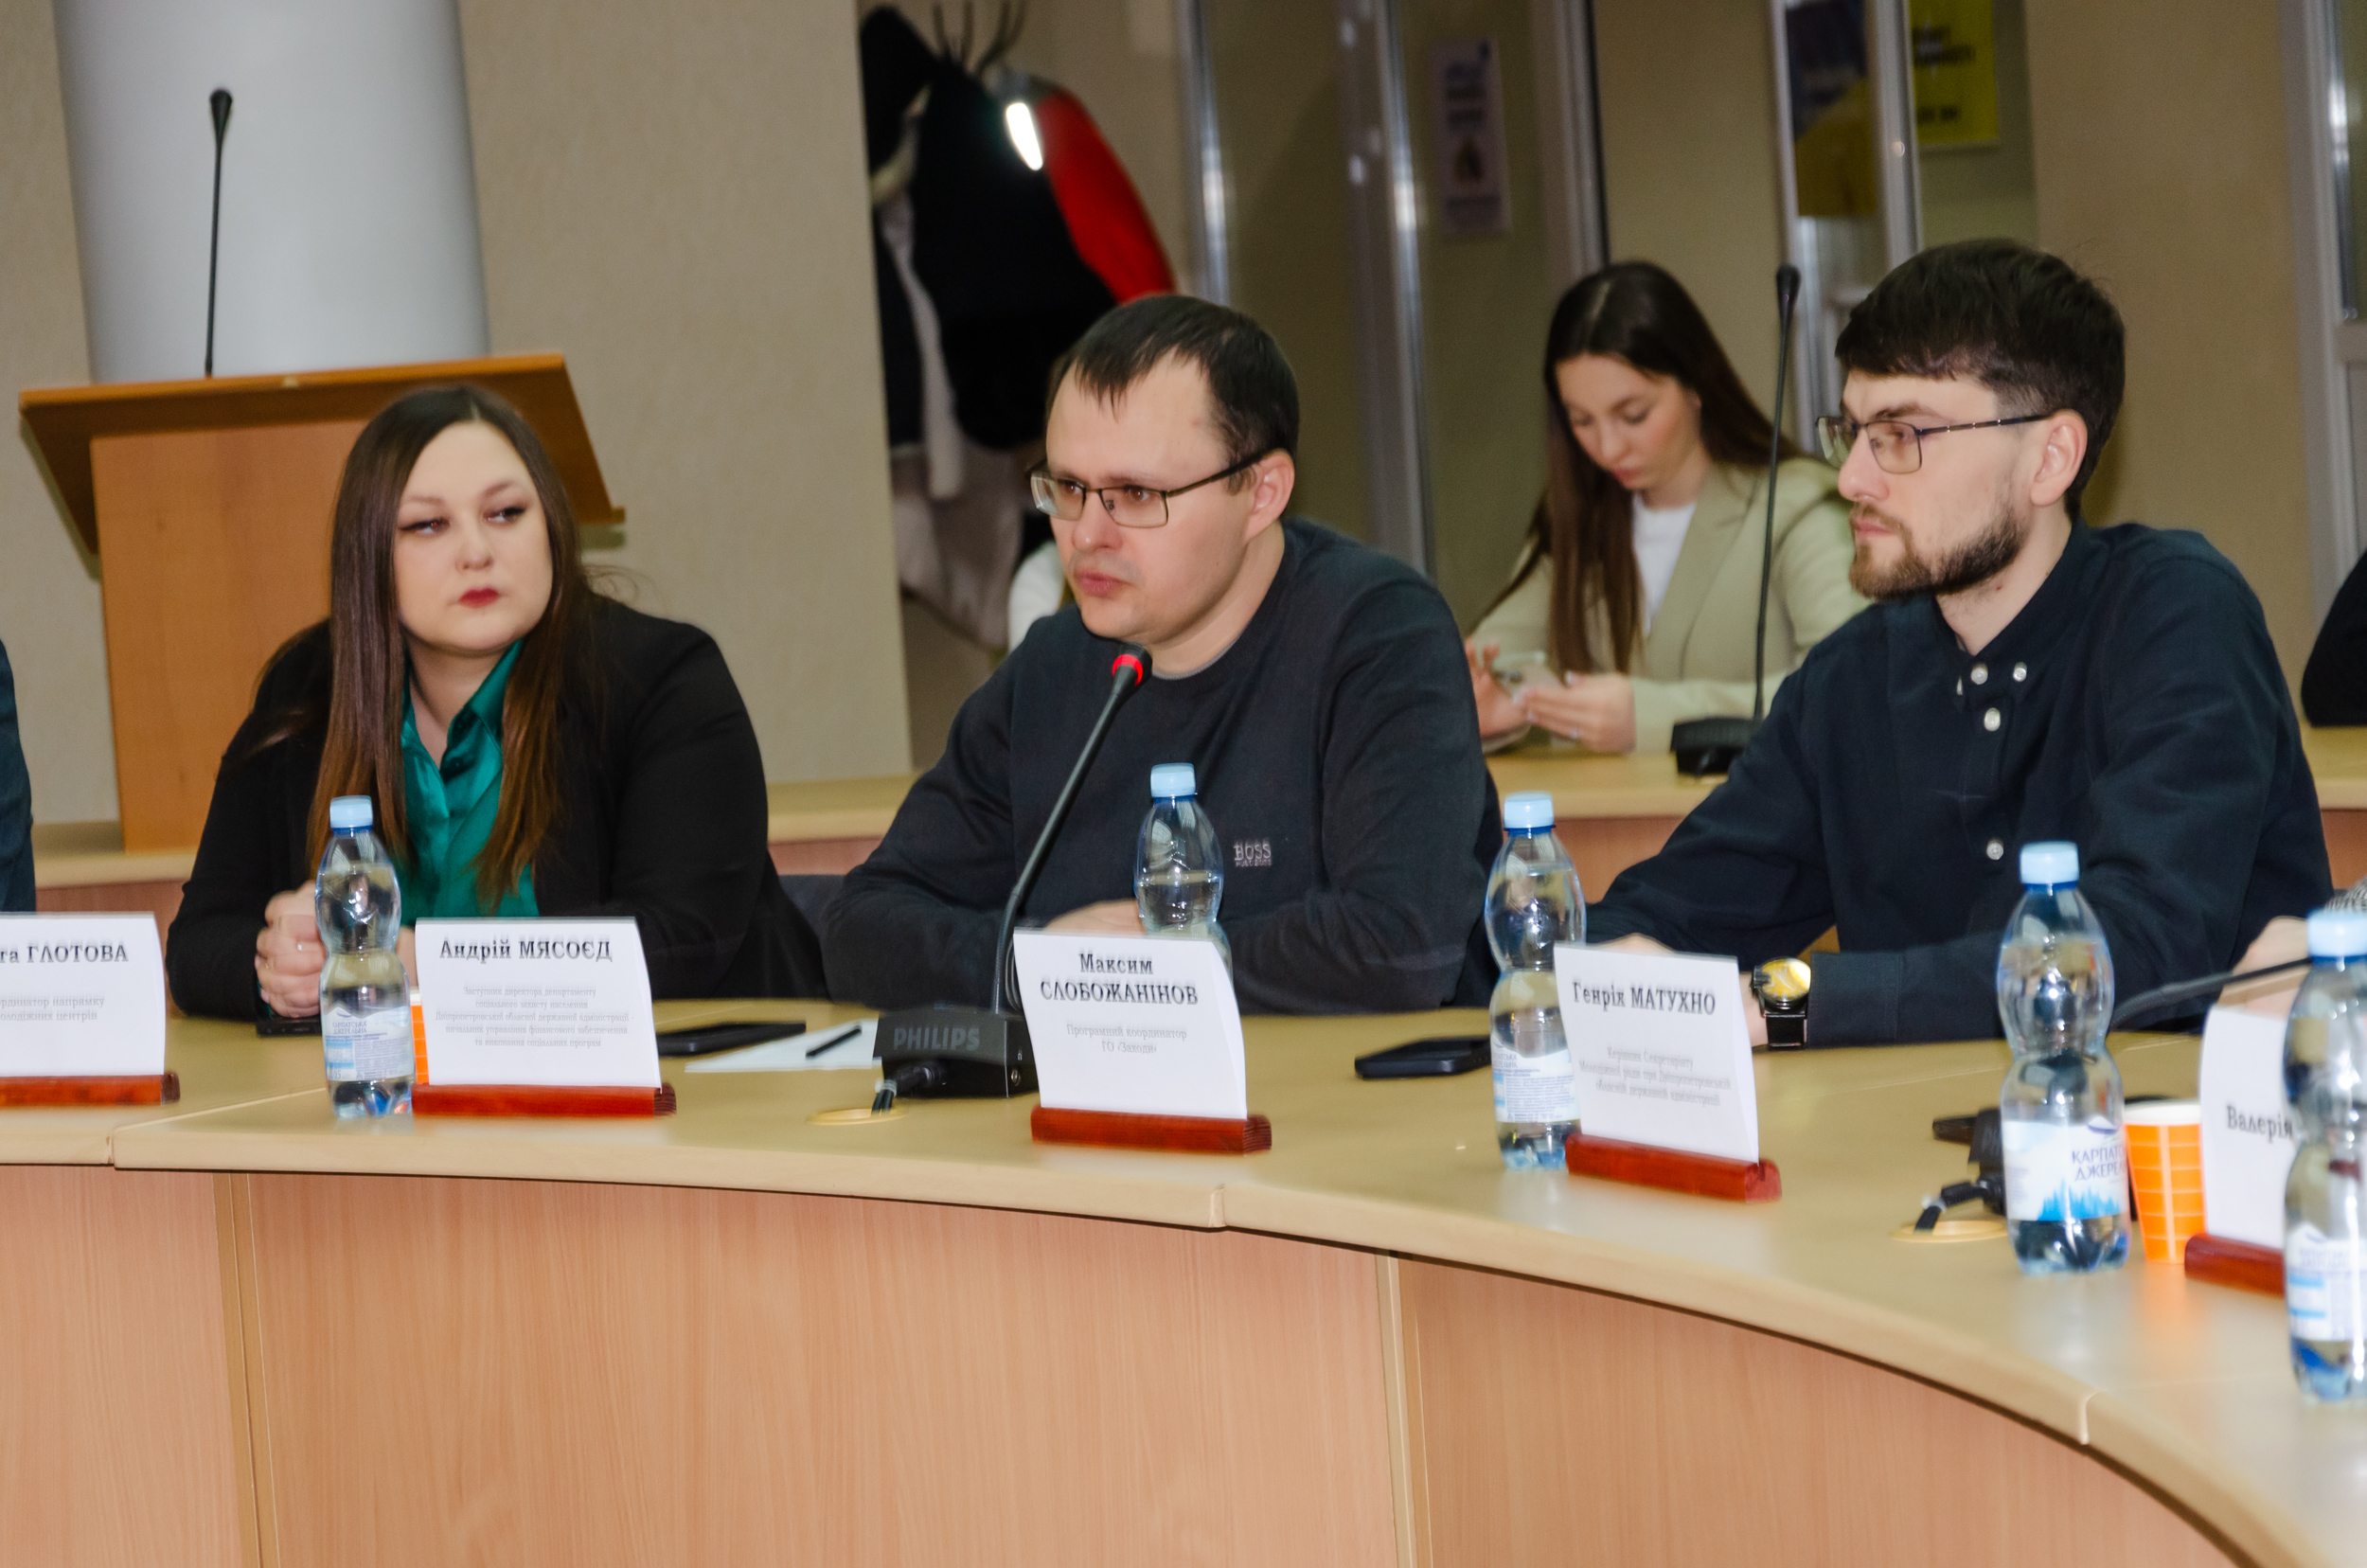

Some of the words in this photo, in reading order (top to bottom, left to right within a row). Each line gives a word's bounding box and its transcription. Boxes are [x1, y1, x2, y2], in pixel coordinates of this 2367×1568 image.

[1234, 843, 1271, 861] BOSS
[27, 944, 129, 964] ГЛОТОВА
[439, 939, 511, 964] Андрій
[519, 940, 613, 963] МЯСОЄД
[1079, 953, 1153, 974] Максим
[1041, 980, 1199, 1005] СЛОБОЖАНІНОВ
[1573, 982, 1626, 1012] Генріх
[1630, 987, 1717, 1016] МАТУХНО
[894, 1027, 980, 1051] PHILIPS
